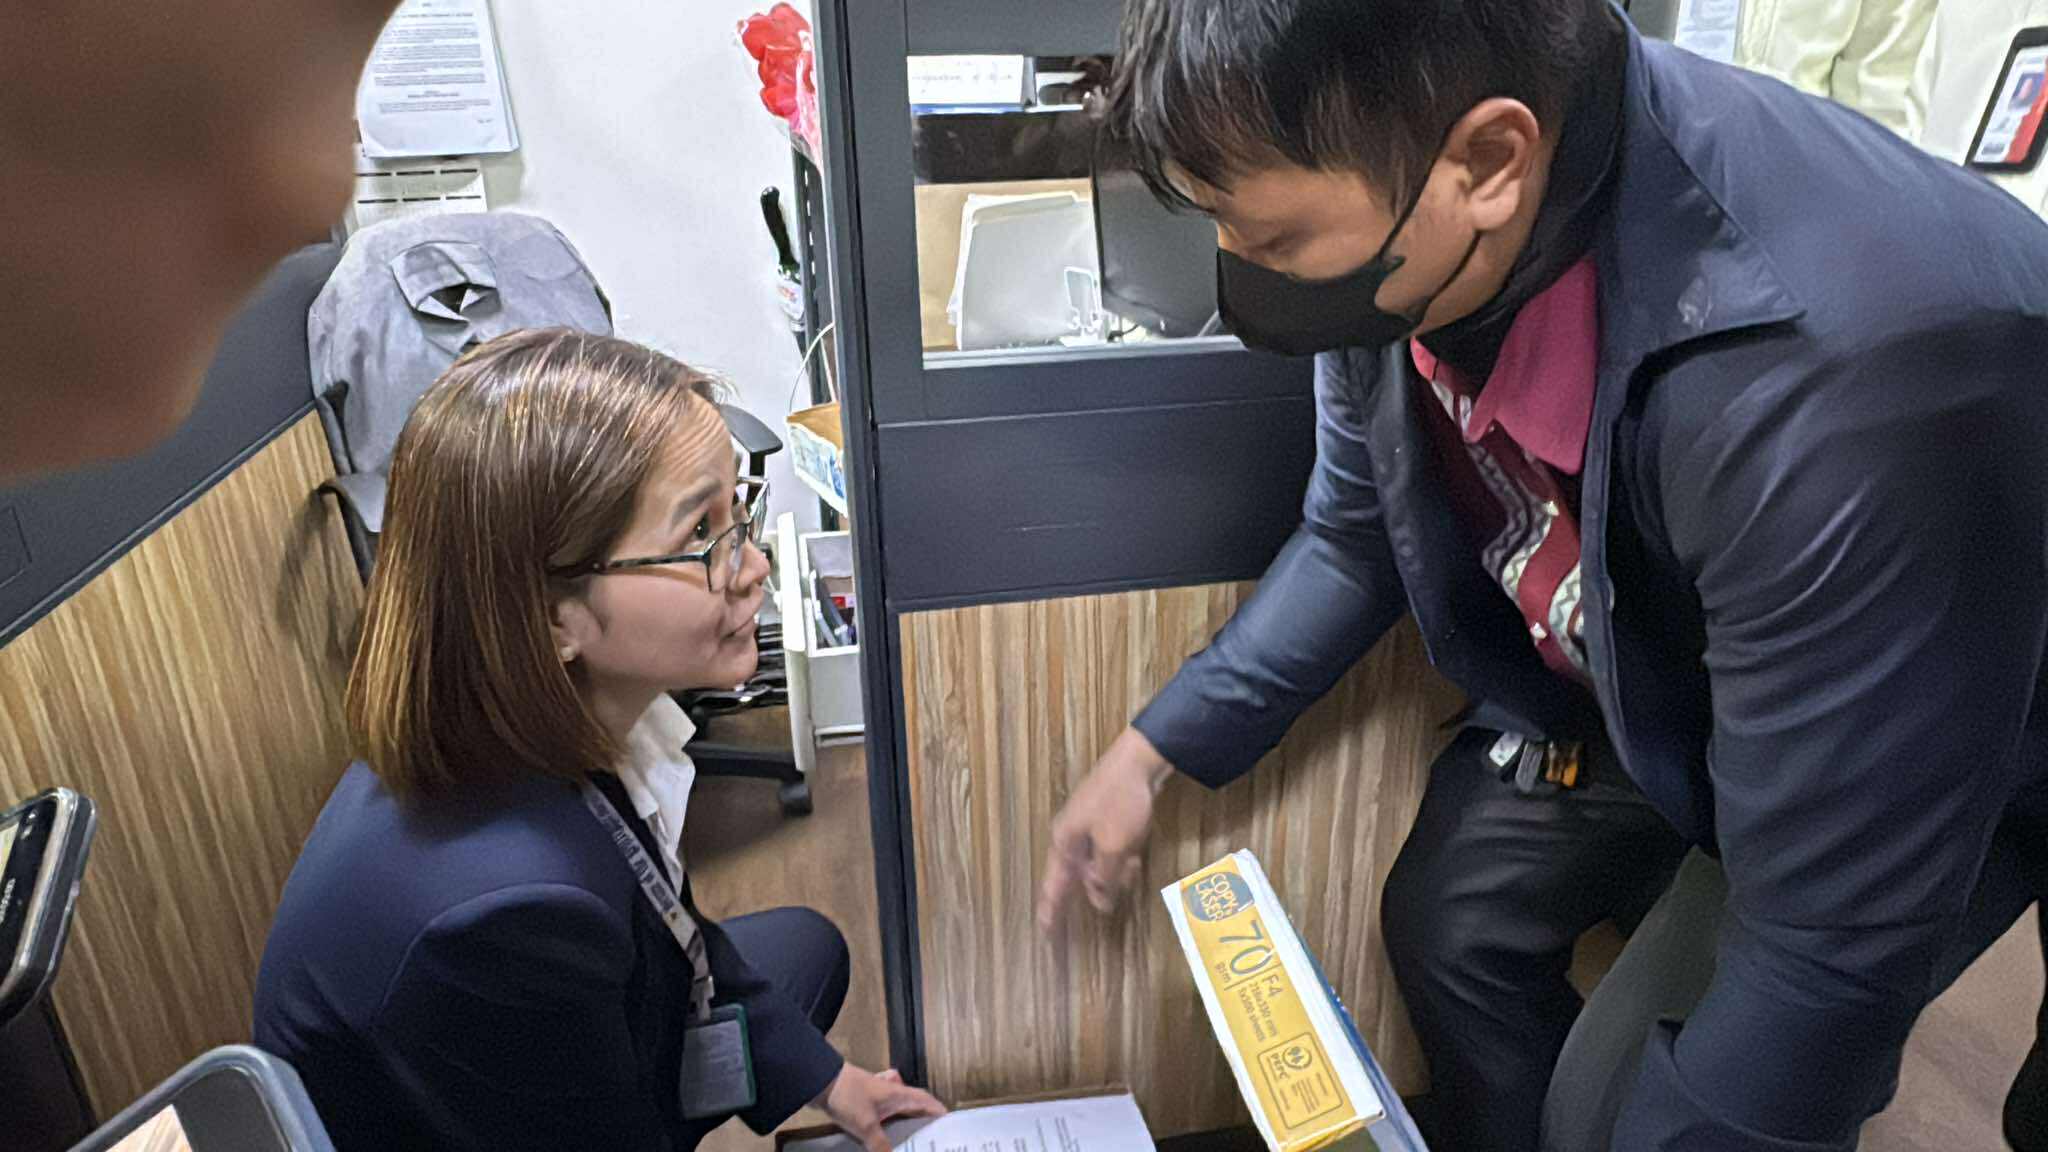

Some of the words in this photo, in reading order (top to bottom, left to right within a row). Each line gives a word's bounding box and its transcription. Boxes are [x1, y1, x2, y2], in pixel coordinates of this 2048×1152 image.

[1195, 879, 1225, 920] LASER
[1211, 873, 1239, 909] COPY
[1218, 919, 1273, 976] 70
[1261, 974, 1283, 997] F4
[1270, 1052, 1288, 1079] PEFC
